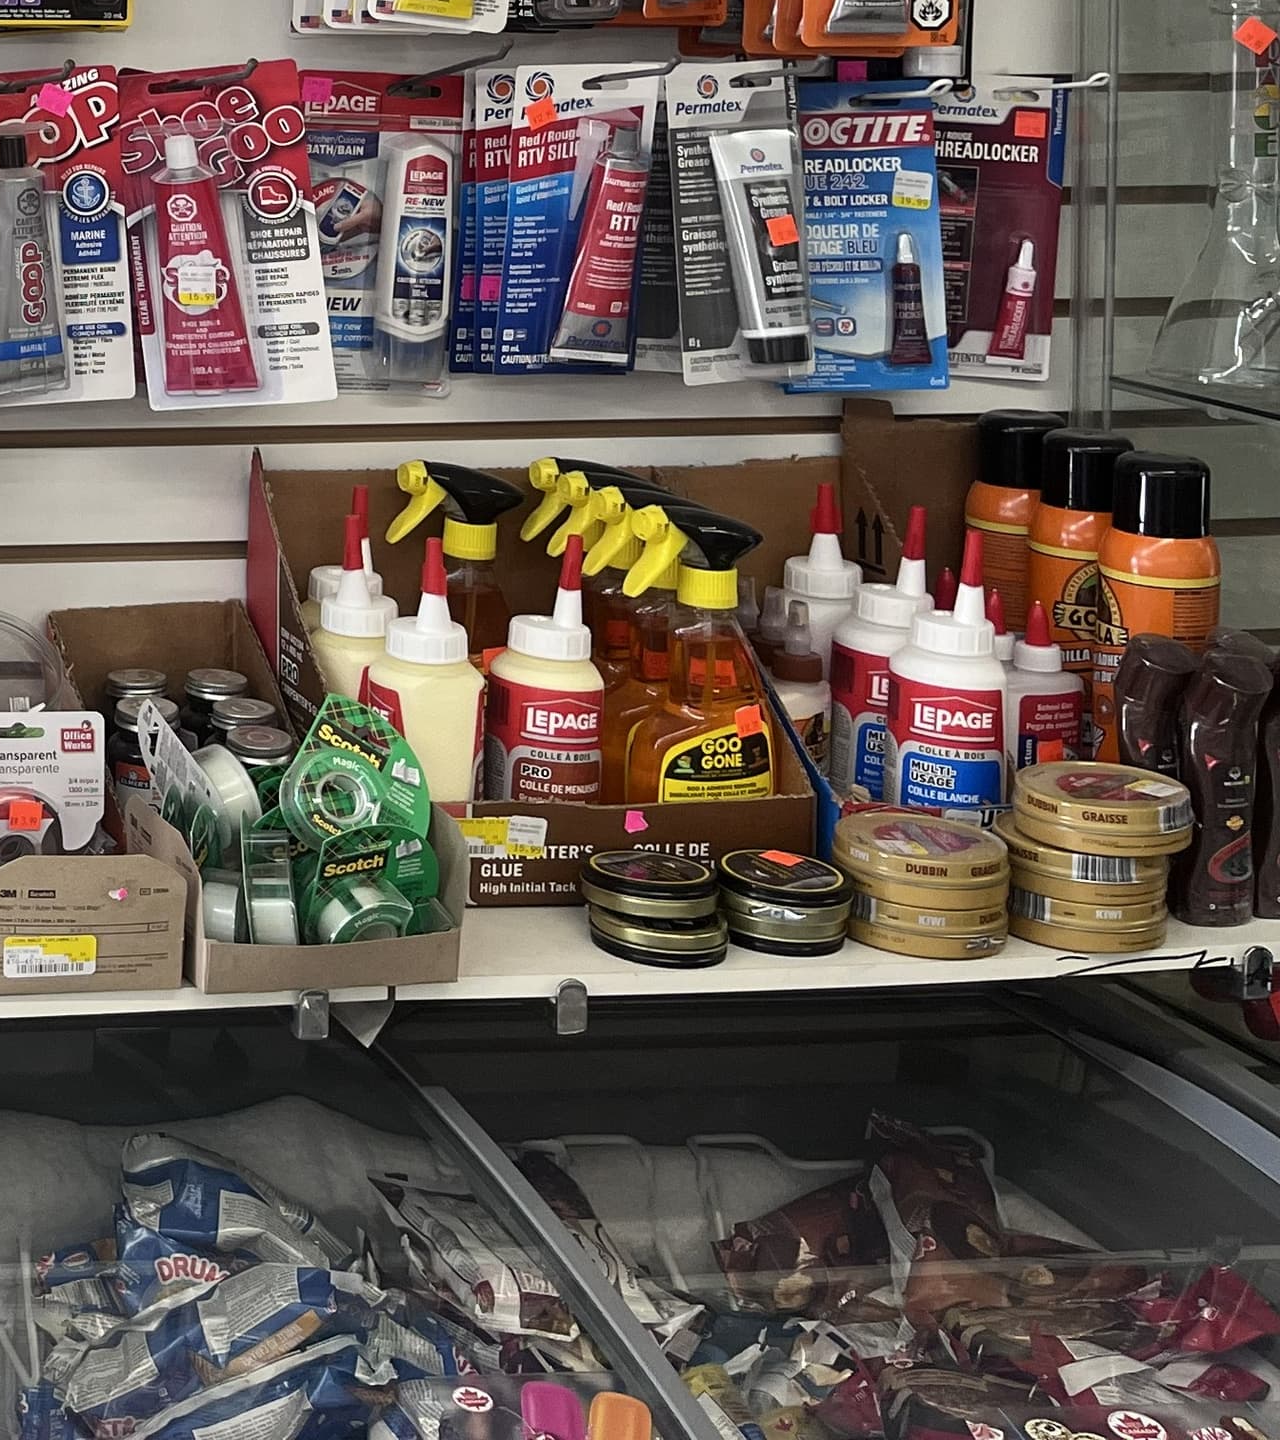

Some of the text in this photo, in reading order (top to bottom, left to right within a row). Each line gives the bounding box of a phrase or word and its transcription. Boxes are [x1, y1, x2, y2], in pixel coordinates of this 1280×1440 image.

[675, 99, 743, 116] Permatex
[824, 194, 888, 206] BOLT LOCKER
[250, 227, 302, 239] SHOE REPAIR
[252, 249, 305, 260] CHAUSSURES
[526, 706, 598, 731] LEPAGE
[913, 702, 993, 731] LEPAGE
[702, 738, 741, 753] GOO
[701, 753, 742, 768] GONE
[520, 763, 551, 779] PRO
[910, 759, 956, 778] MULTI-
[910, 771, 954, 789] USAGE
[324, 854, 385, 878] Scotch
[481, 863, 523, 877] GLUE
[906, 863, 948, 877] DUBBIN
[480, 880, 575, 895] High Initial Tack
